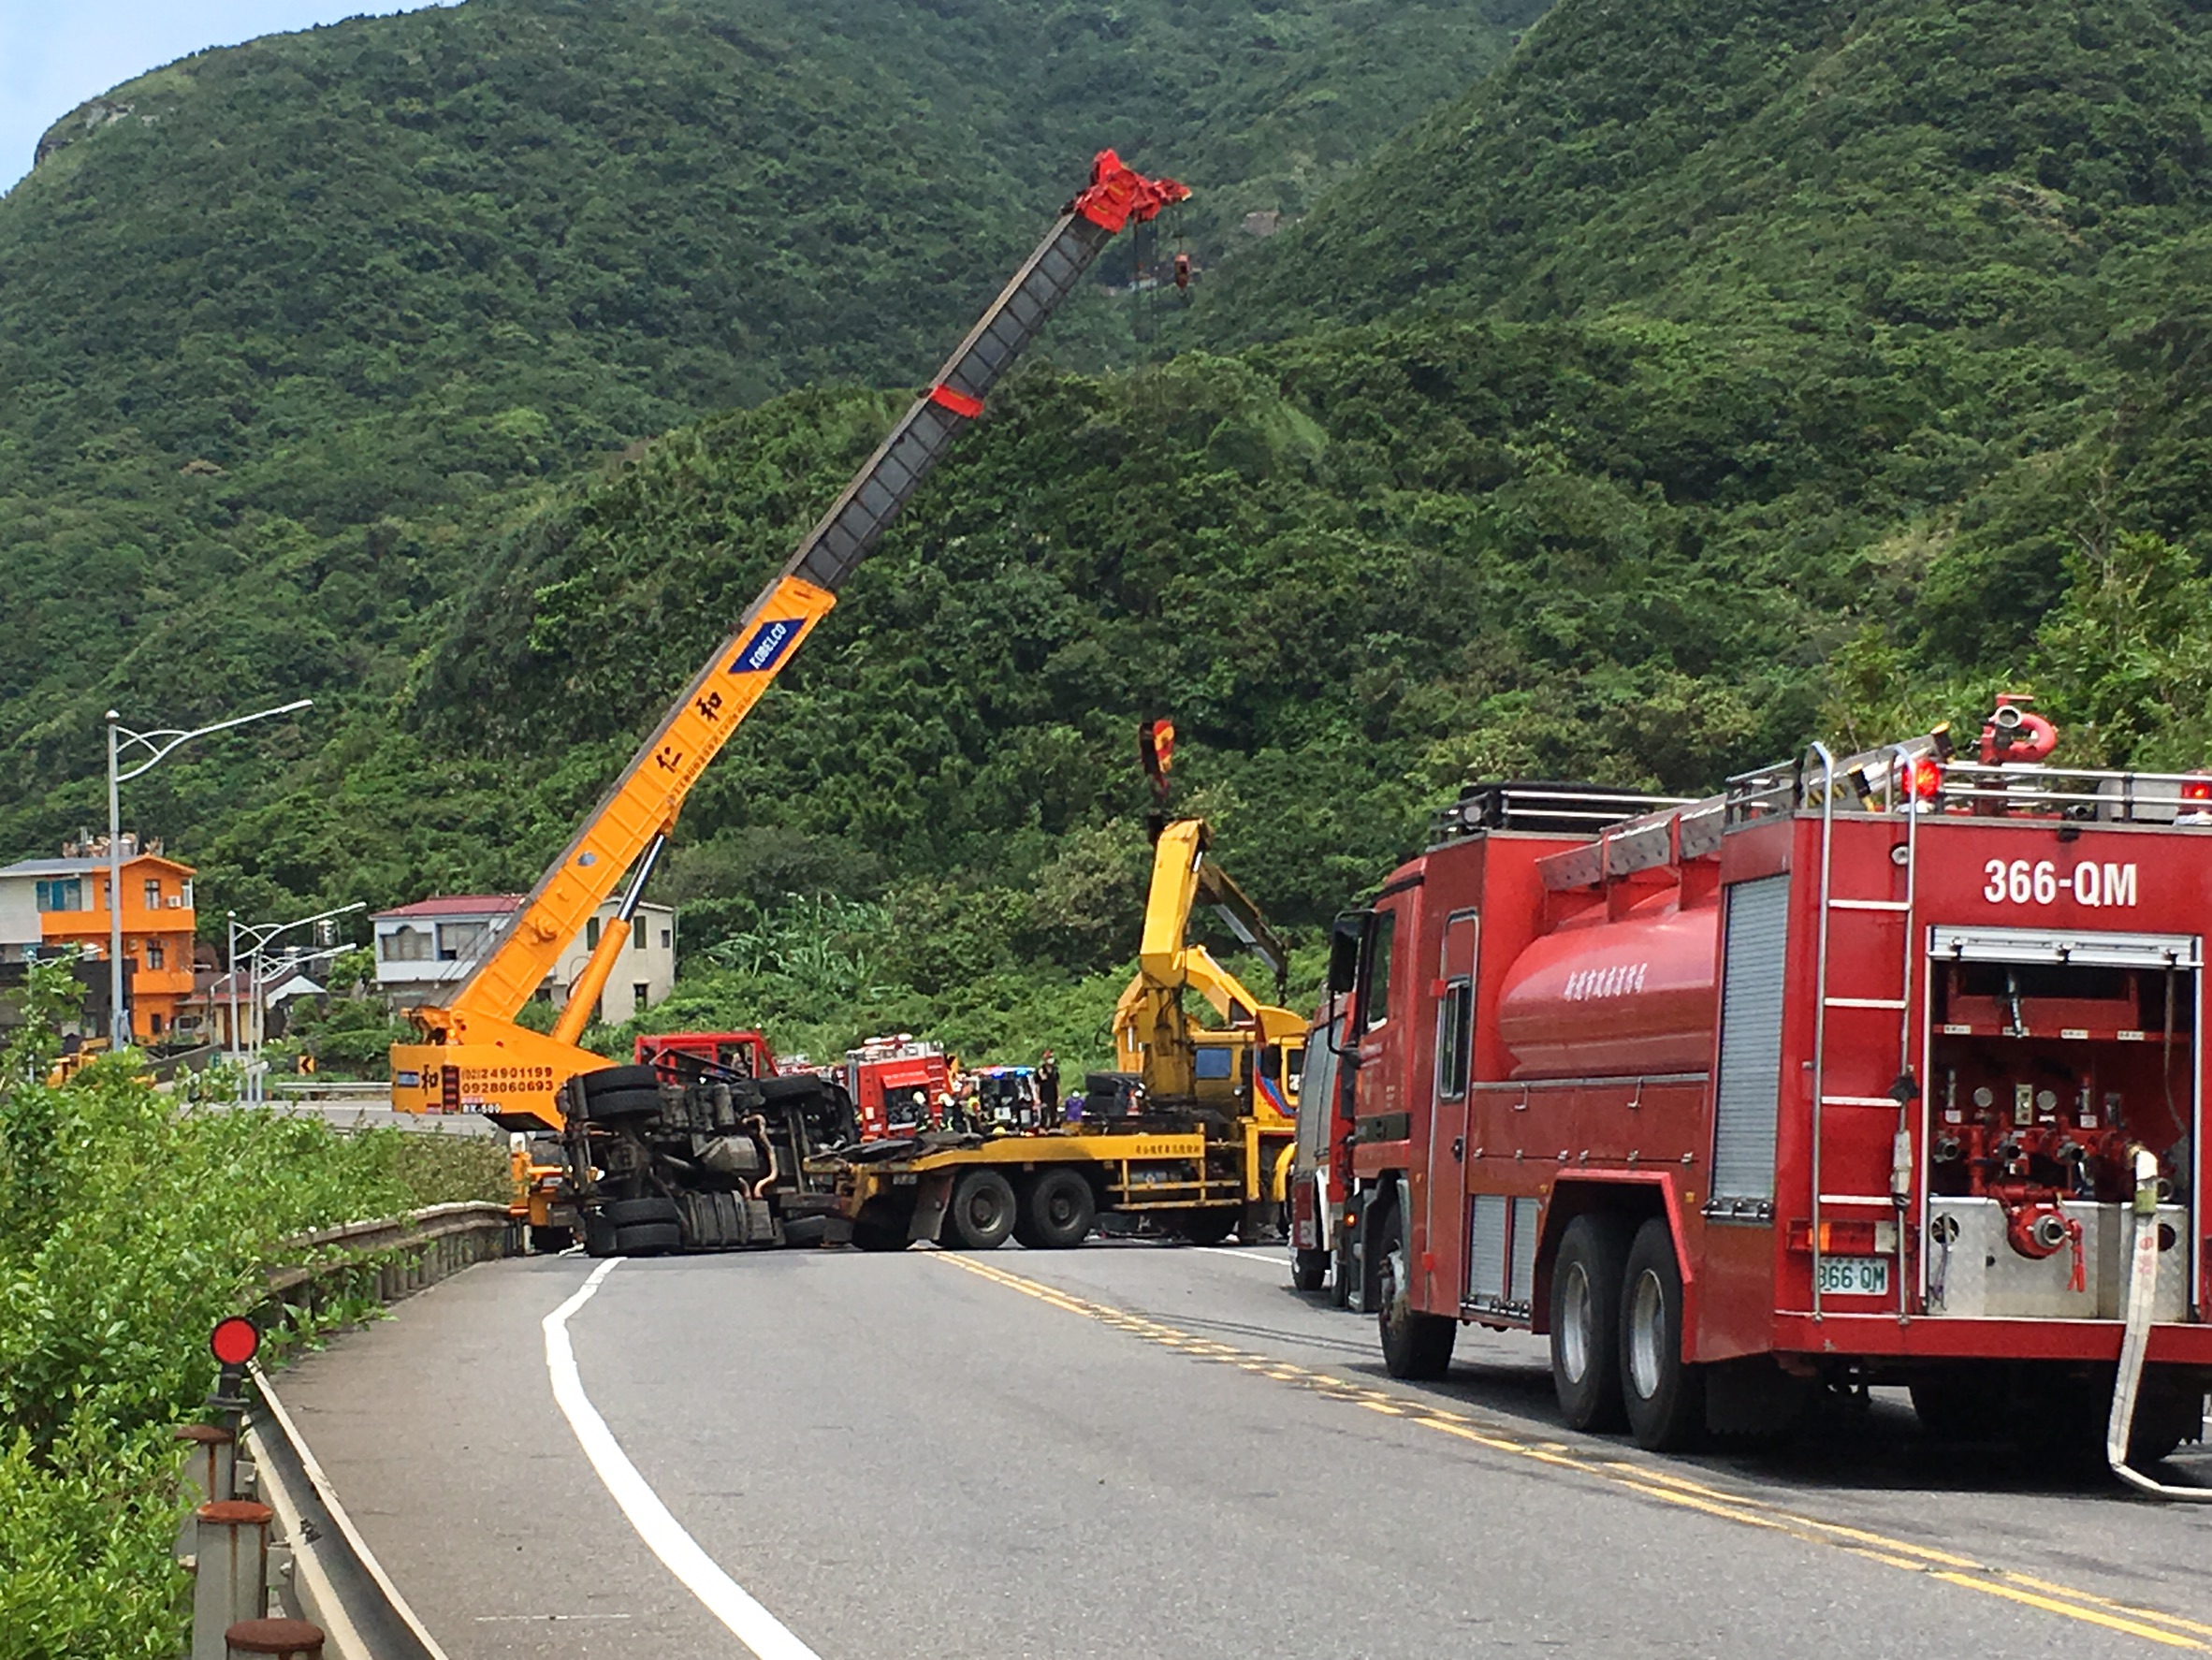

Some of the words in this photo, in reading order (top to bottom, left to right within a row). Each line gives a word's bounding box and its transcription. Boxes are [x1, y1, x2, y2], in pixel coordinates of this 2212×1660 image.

[749, 622, 787, 670] KOBELCO
[1984, 859, 2137, 908] 366-QM
[421, 1064, 439, 1097] 和
